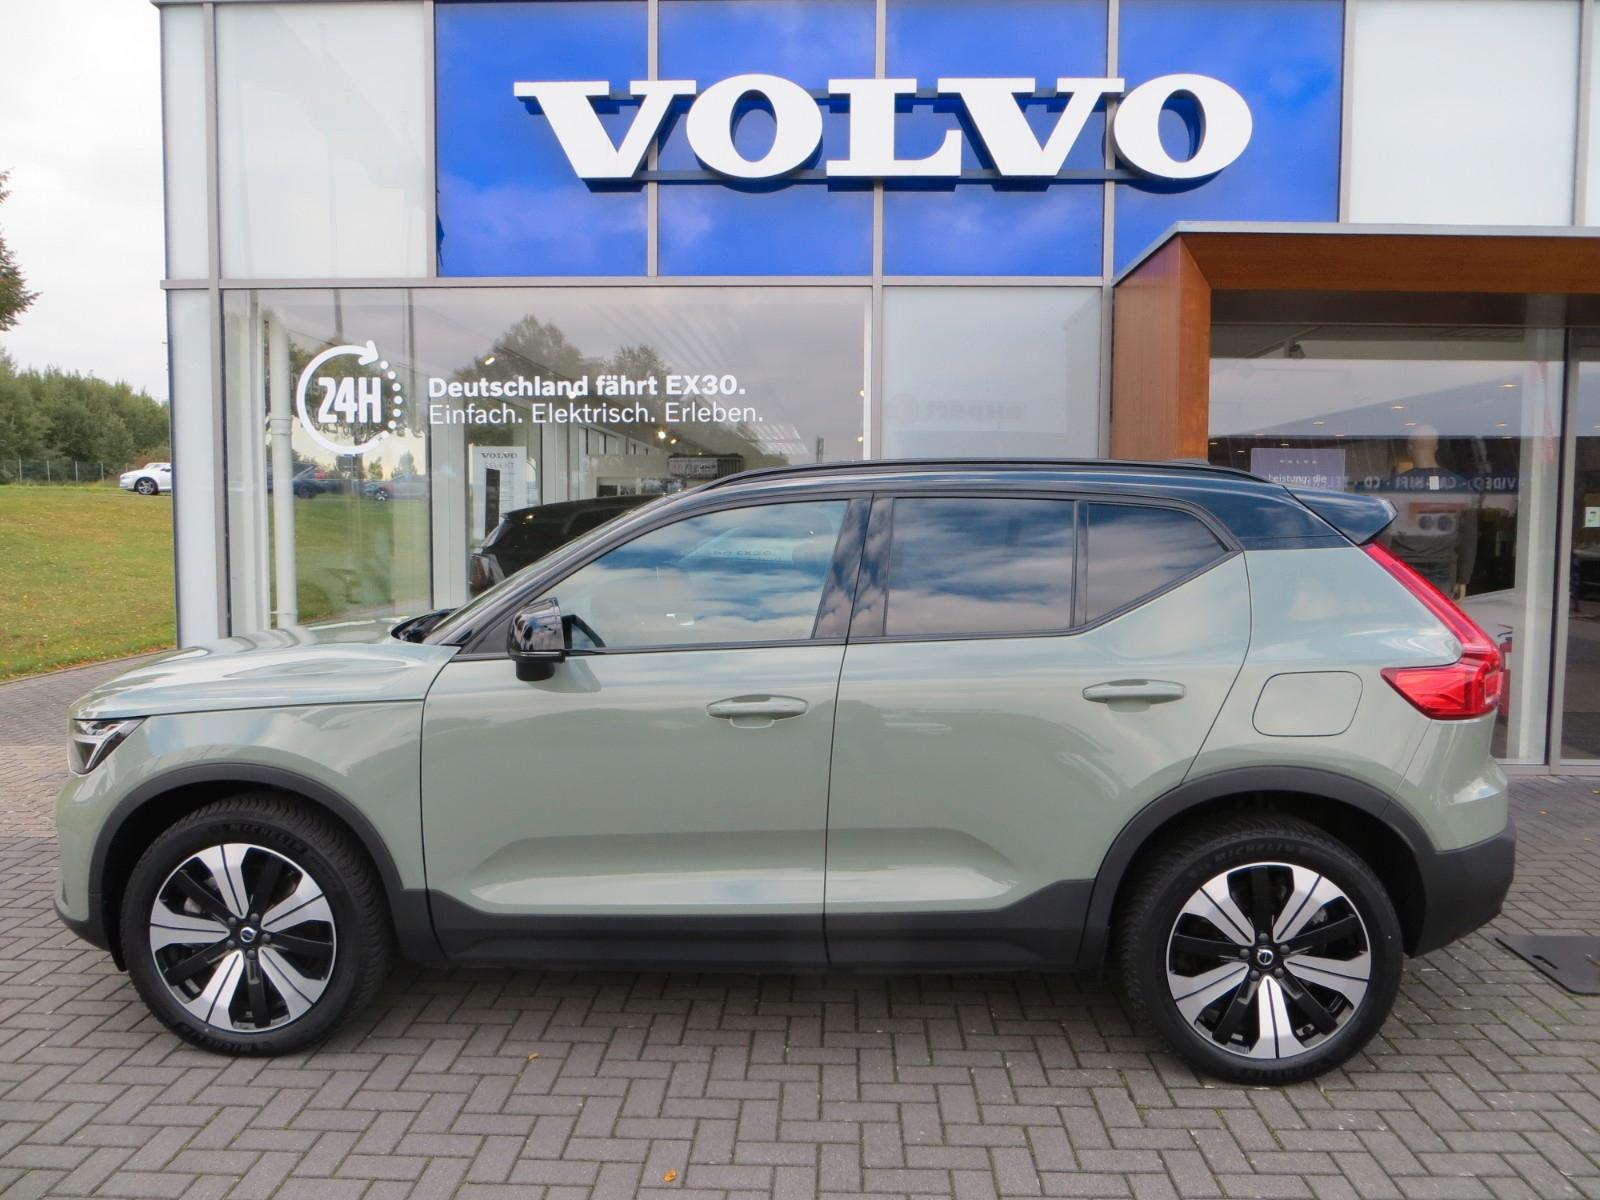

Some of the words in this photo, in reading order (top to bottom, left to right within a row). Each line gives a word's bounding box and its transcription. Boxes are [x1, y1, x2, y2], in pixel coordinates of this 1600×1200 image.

[513, 73, 1253, 180] VOLVO
[317, 376, 382, 424] 24H
[428, 375, 588, 398] Deutschland
[595, 374, 658, 396] fährt
[666, 374, 746, 395] EX30.
[429, 403, 523, 425] Einfach.
[532, 401, 655, 424] Elektrisch.
[665, 401, 764, 422] Erleben.
